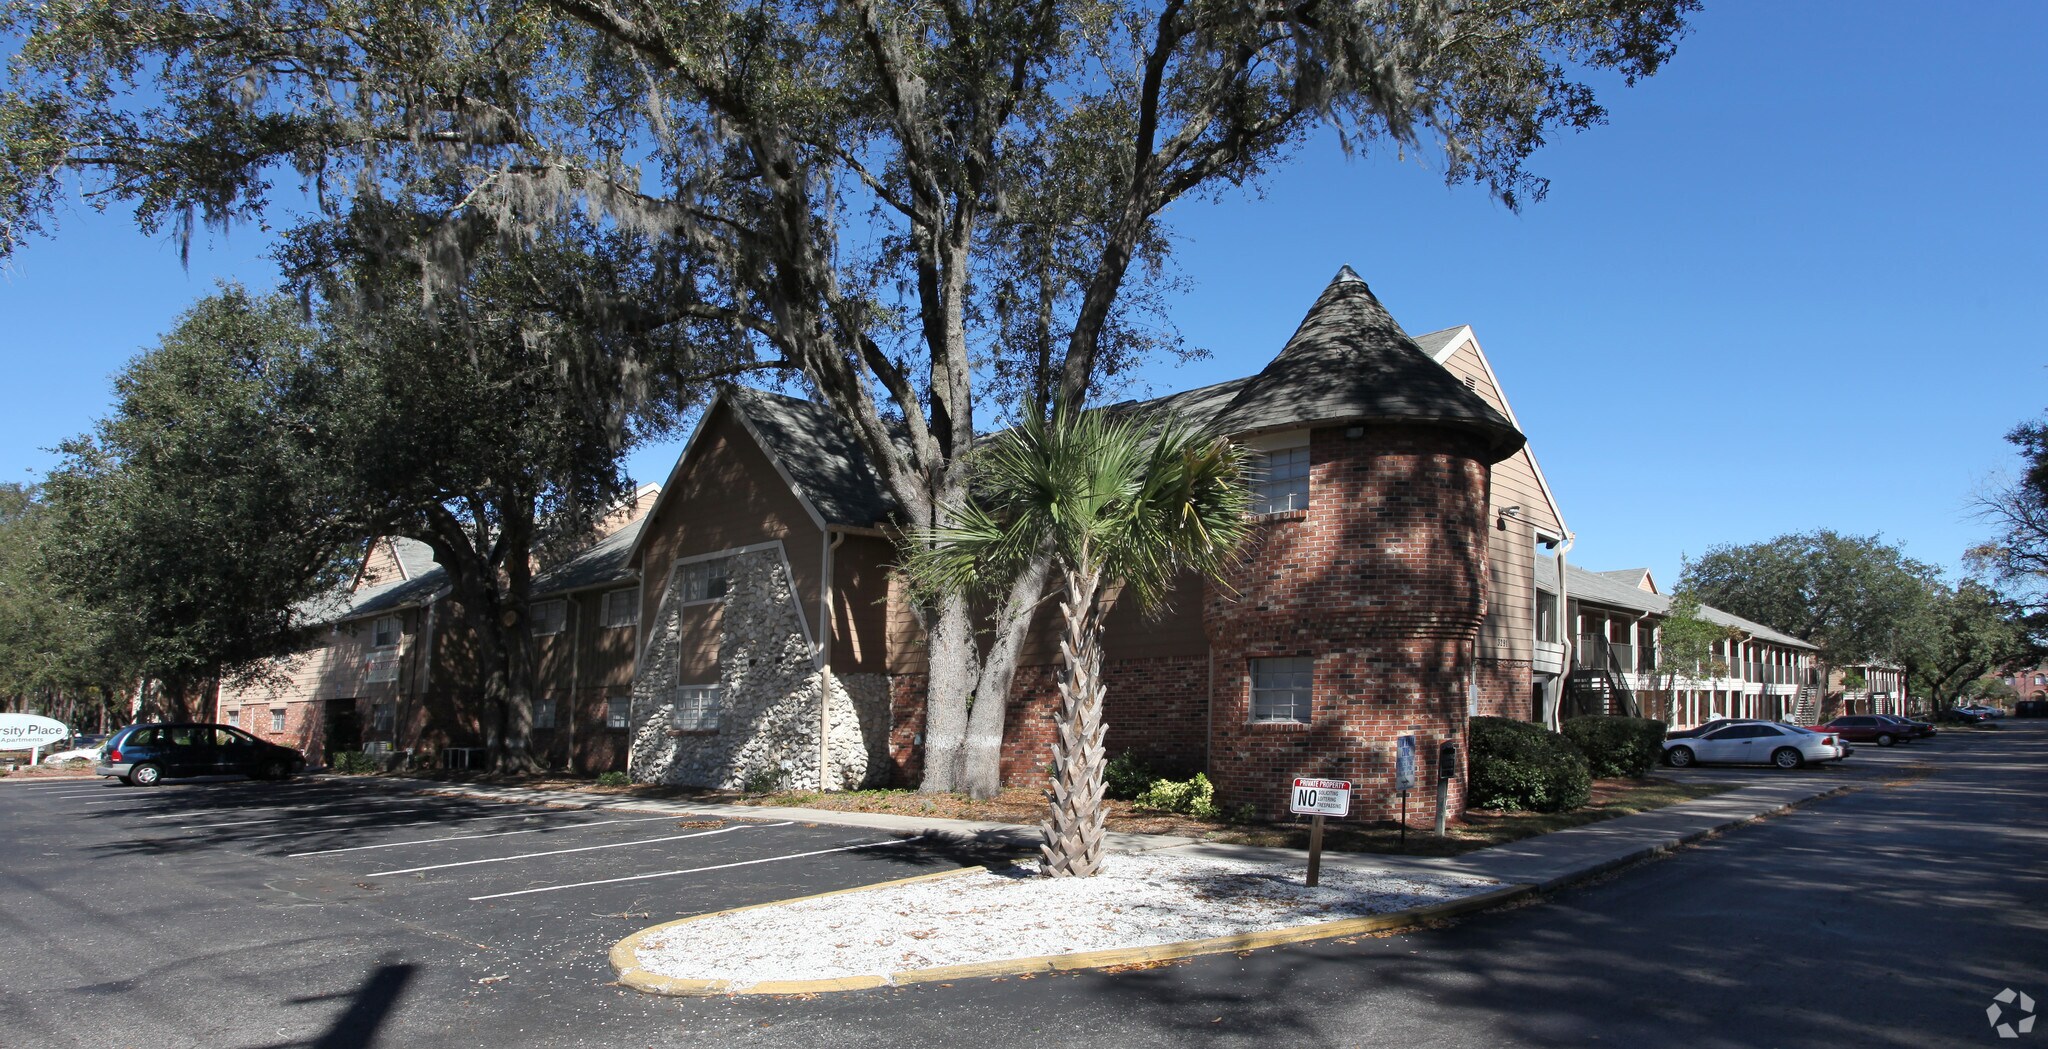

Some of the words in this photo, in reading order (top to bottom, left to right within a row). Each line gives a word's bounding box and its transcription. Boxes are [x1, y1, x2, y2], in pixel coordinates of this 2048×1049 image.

[28, 725, 62, 735] Place
[1299, 779, 1319, 787] PRIVATE
[1319, 780, 1344, 789] PROPERTY
[1298, 789, 1317, 807] NO
